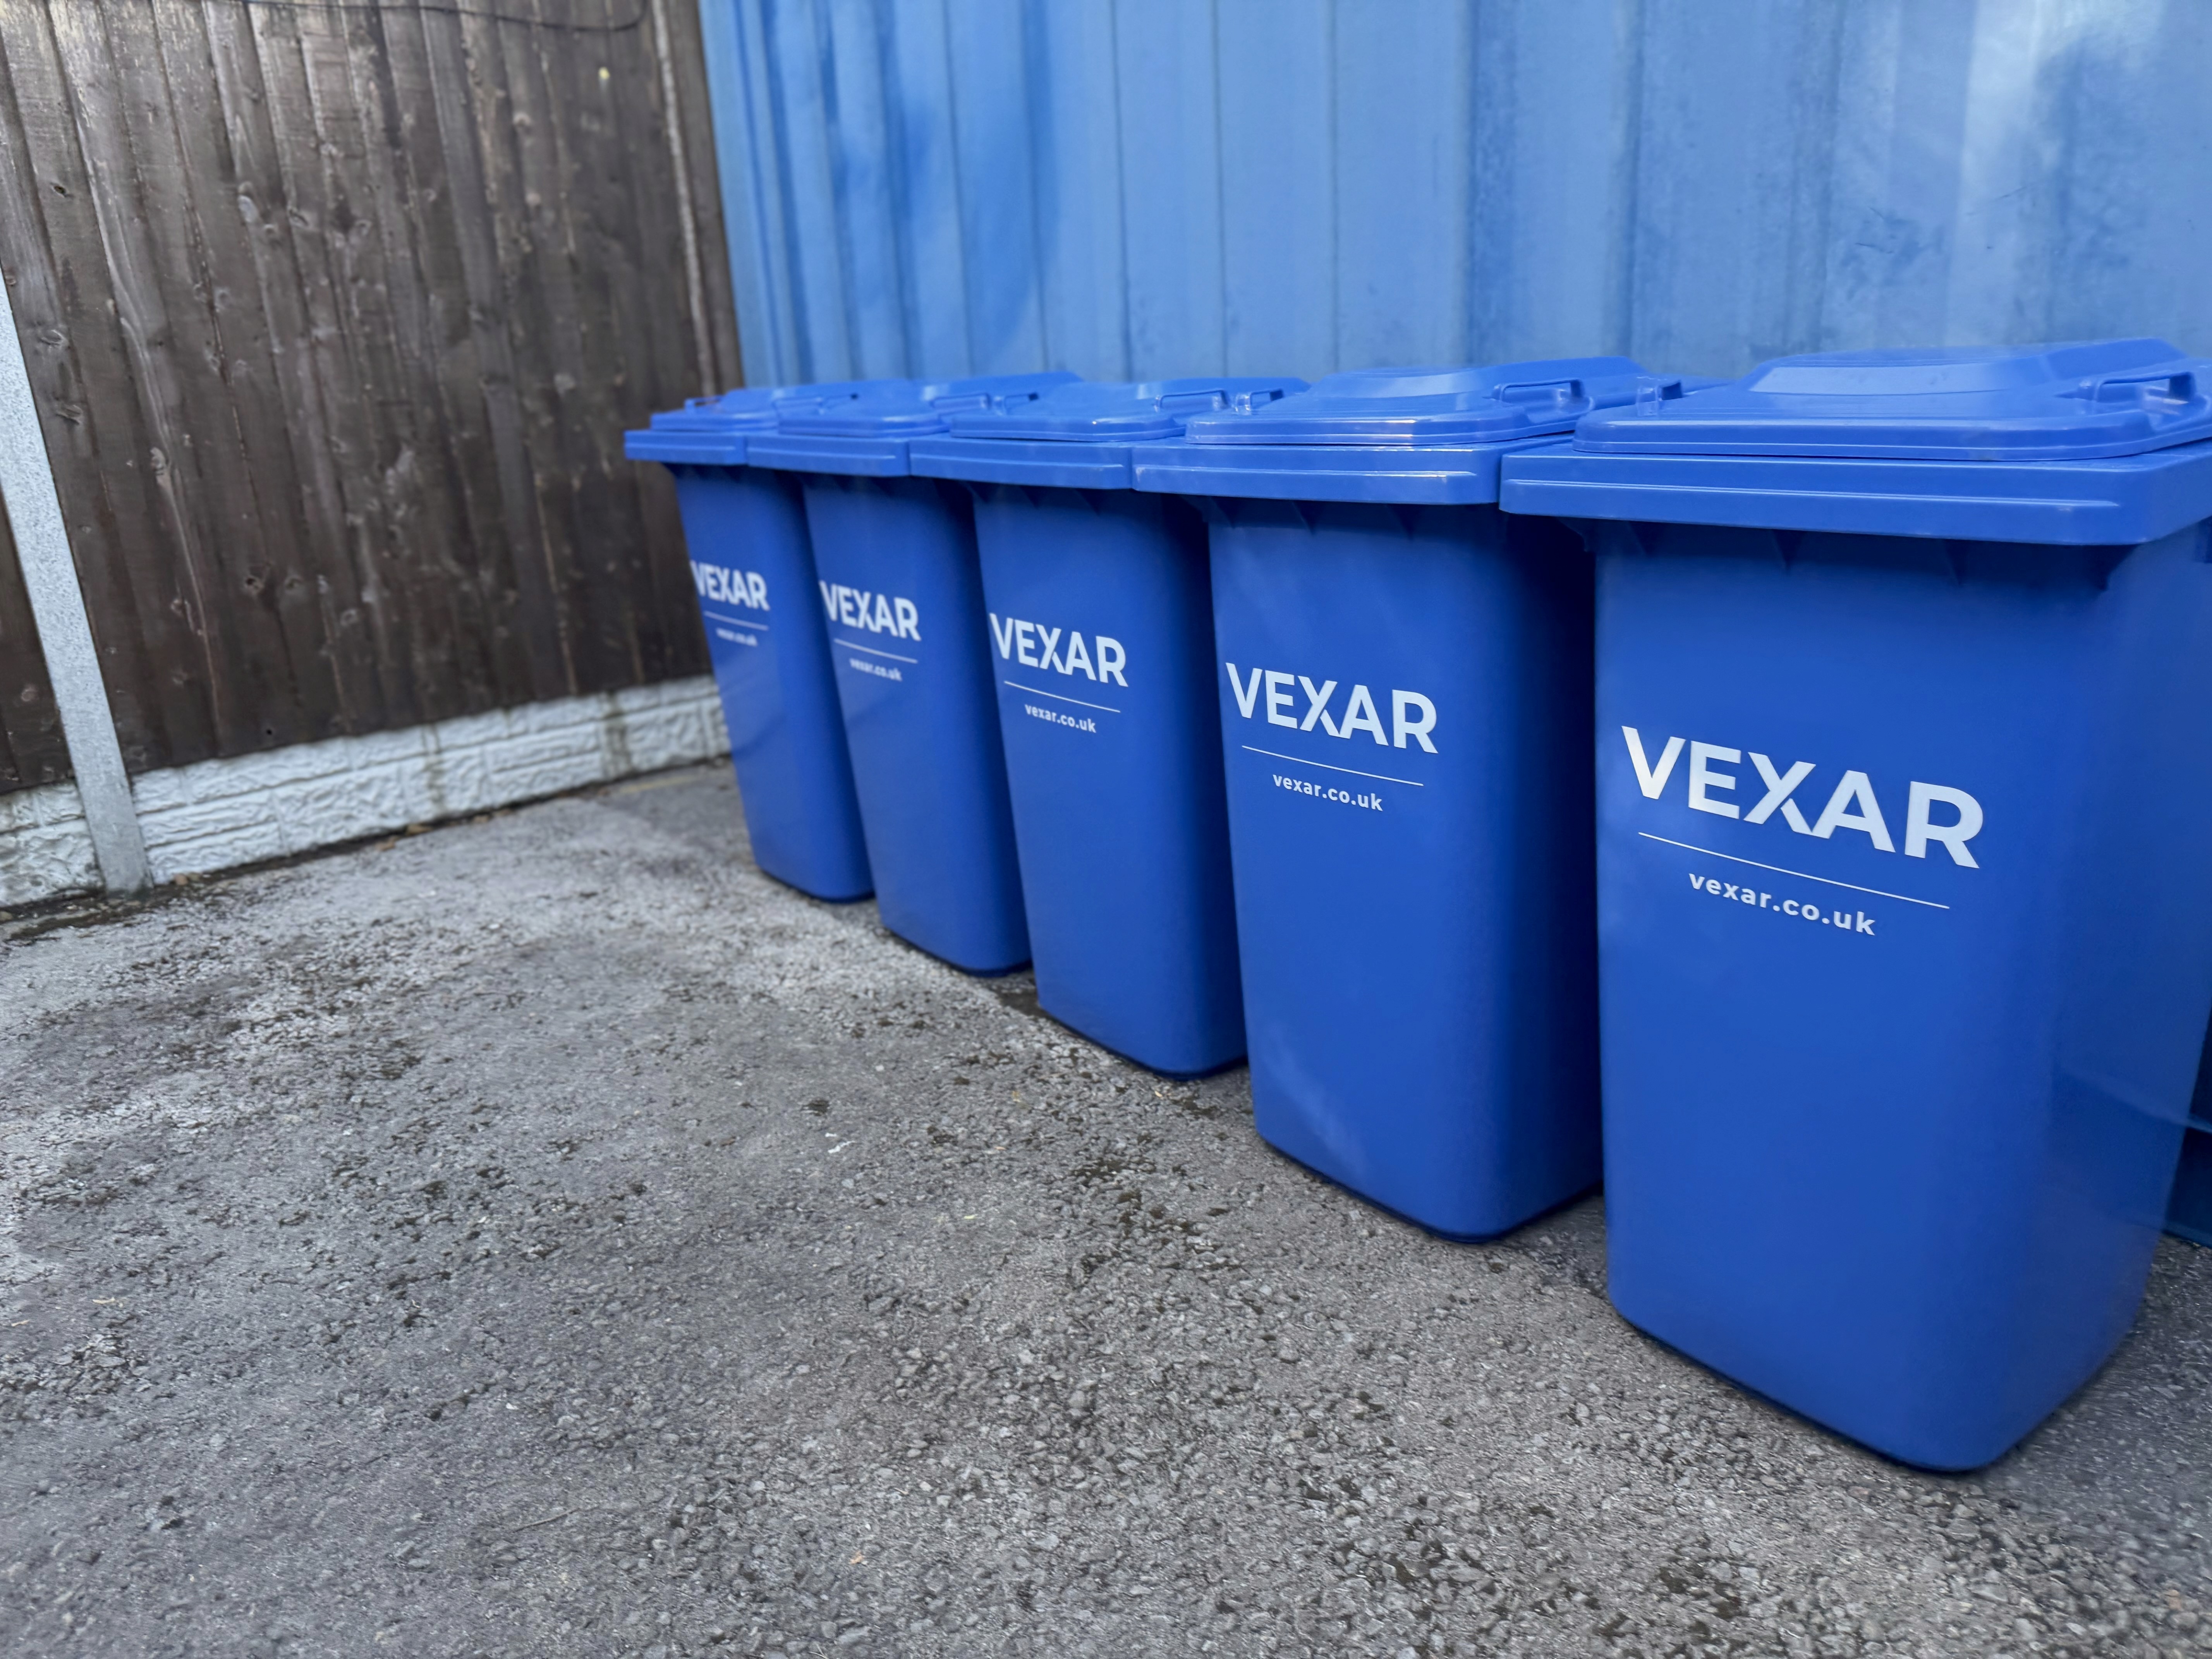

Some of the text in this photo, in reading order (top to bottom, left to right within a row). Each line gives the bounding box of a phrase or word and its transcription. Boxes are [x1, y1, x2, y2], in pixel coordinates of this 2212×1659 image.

[690, 561, 770, 610] VEXAR
[819, 581, 921, 641] VEXAR
[989, 613, 1128, 687] VEXAR
[1025, 704, 1096, 733] vexar.co.uk
[1226, 662, 1438, 754] VEXAR
[1273, 775, 1383, 811] vexar.co.uk
[1621, 726, 1983, 868] VEXAR
[1689, 873, 1875, 936] vexar.co.uk
